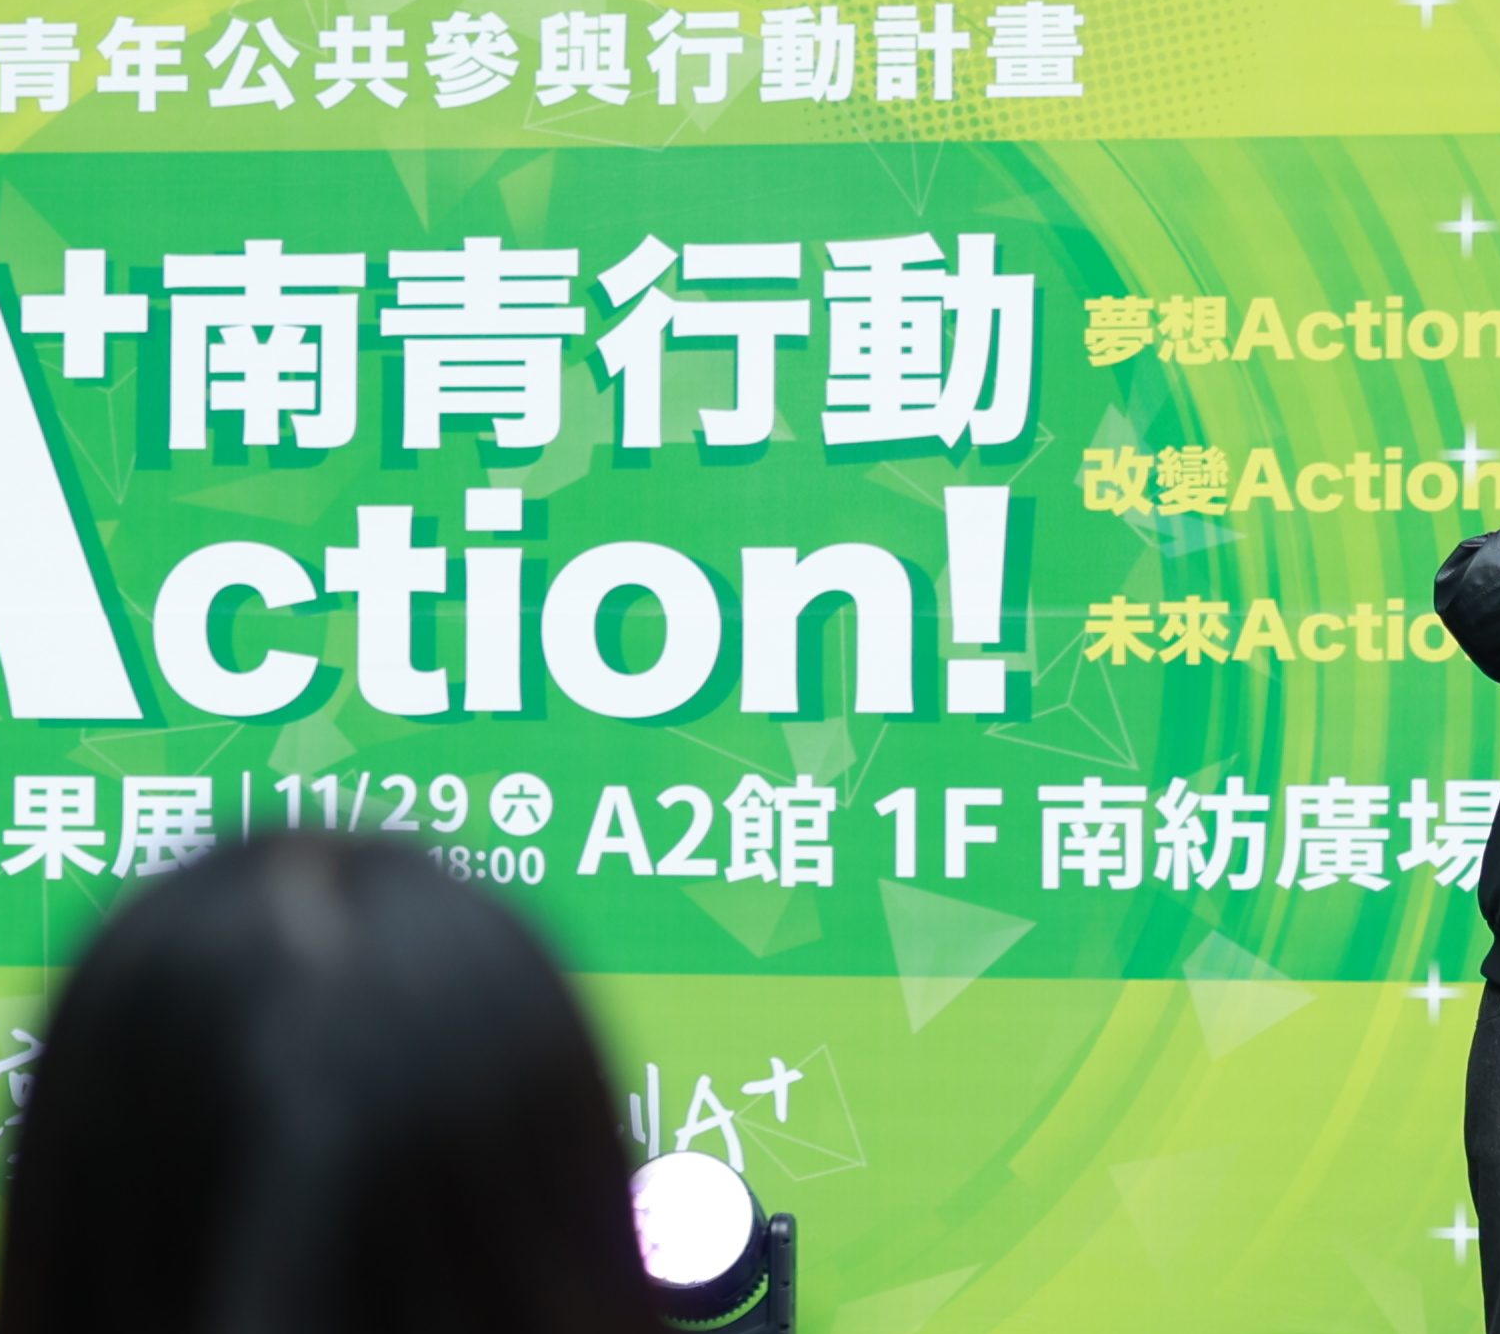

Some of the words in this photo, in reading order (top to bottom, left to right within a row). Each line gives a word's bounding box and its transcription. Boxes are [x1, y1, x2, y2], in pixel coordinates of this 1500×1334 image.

[1084, 596, 1467, 665] 未來Actio
[273, 771, 469, 833] 11/29
[576, 774, 837, 889] A2館
[873, 787, 1004, 879] 1F
